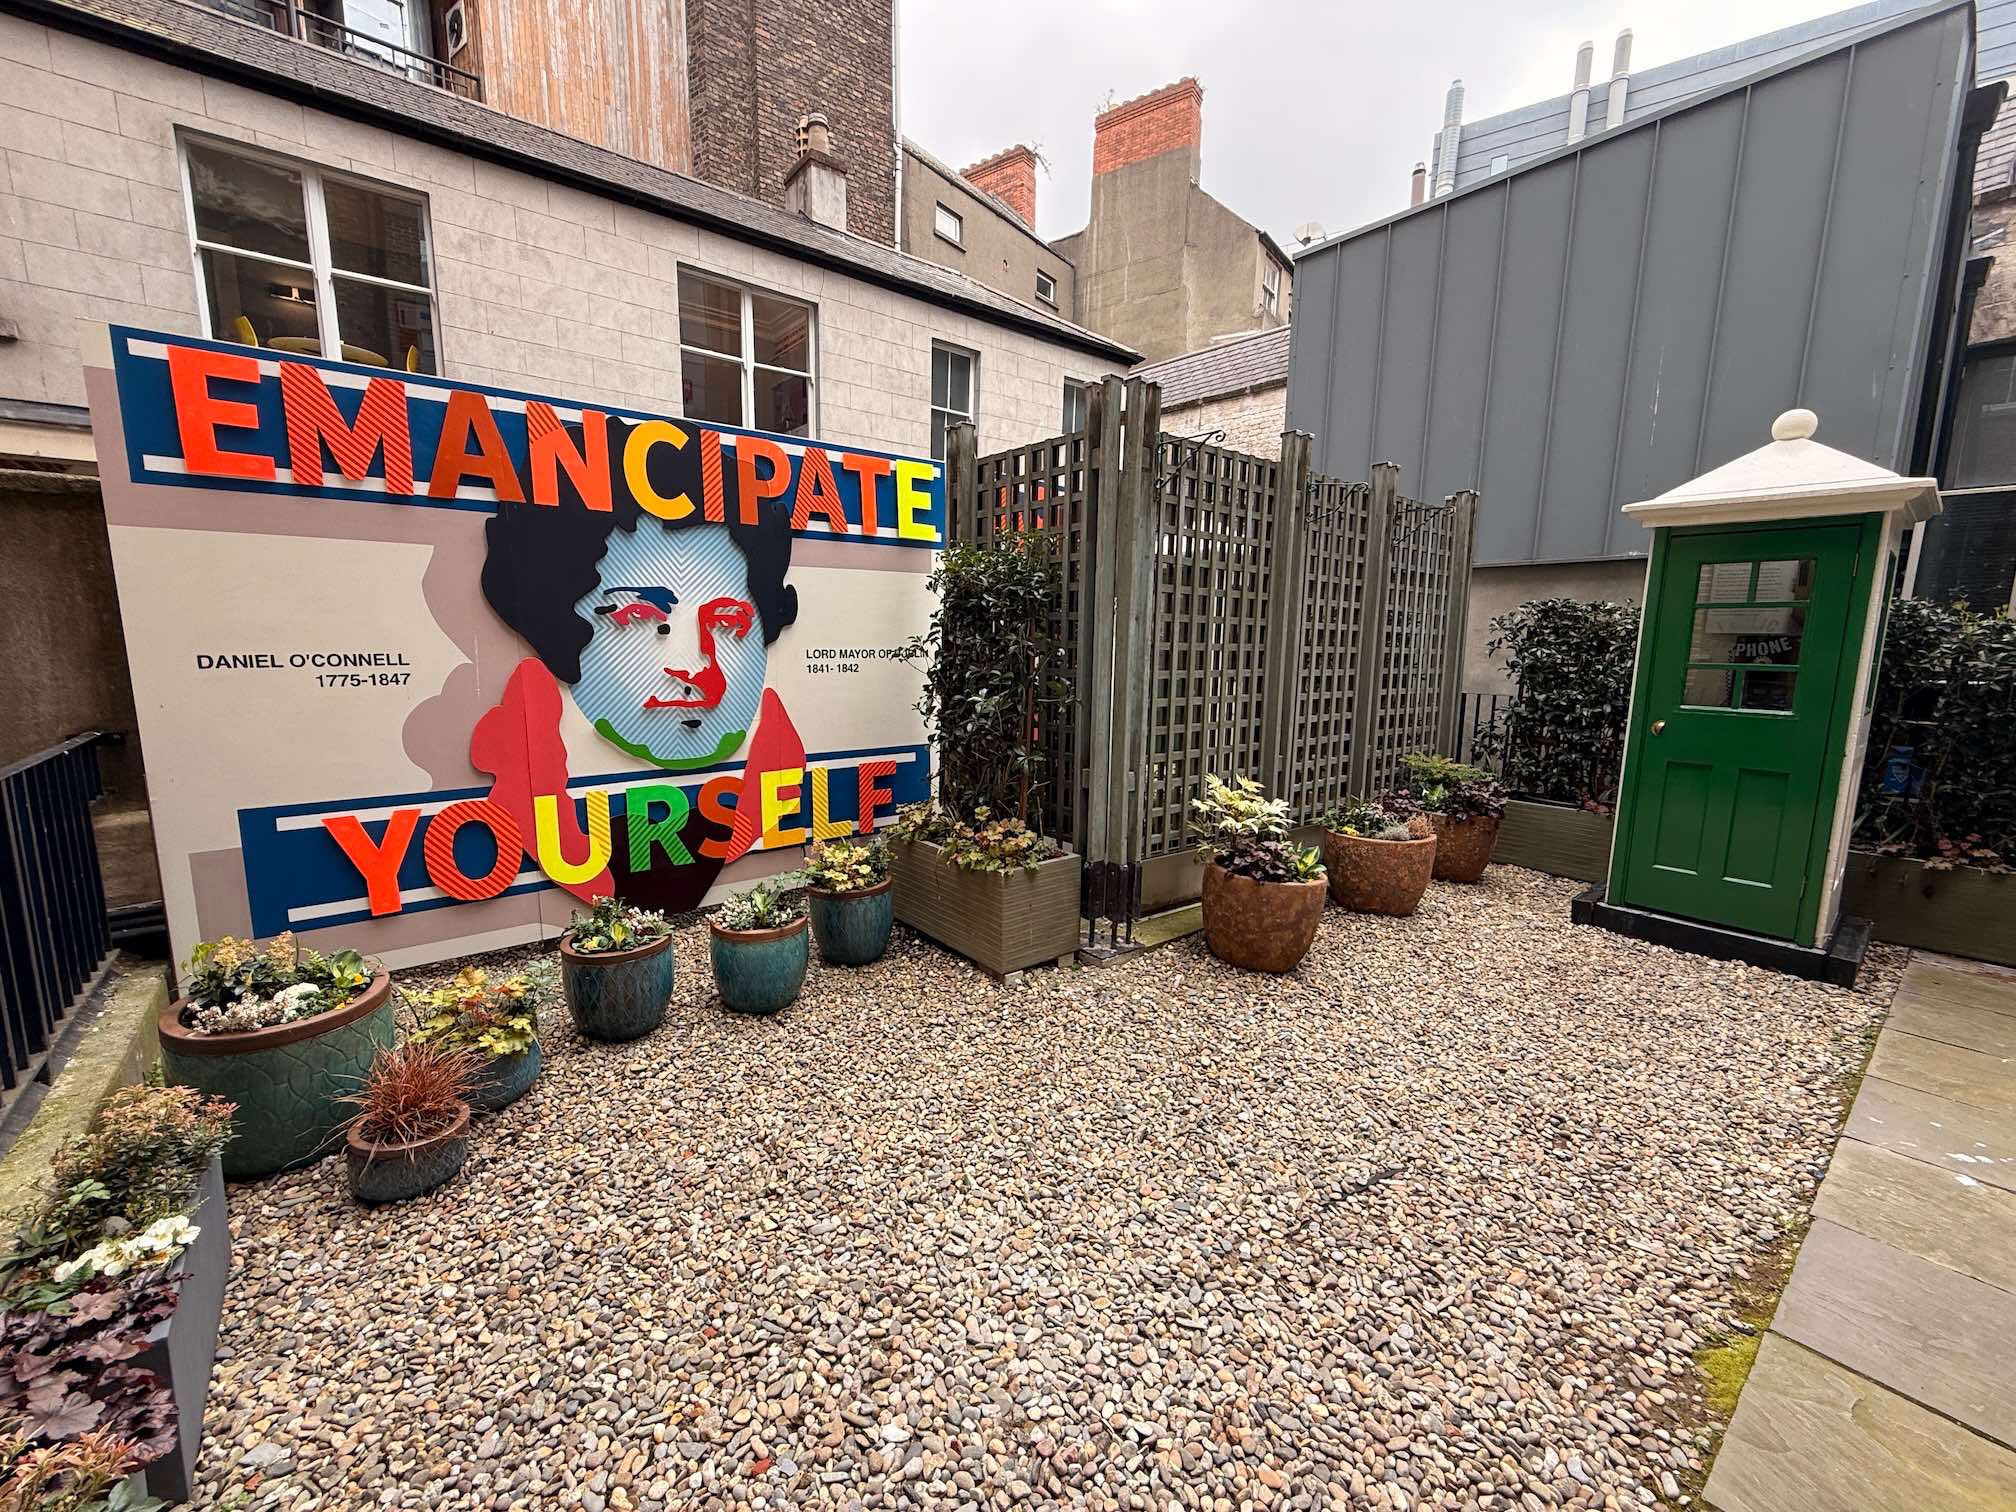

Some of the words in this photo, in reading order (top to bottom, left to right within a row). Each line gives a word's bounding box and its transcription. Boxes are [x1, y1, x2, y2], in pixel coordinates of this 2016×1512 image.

[166, 345, 942, 543] EMANCIPATE
[805, 649, 836, 659] LORD
[839, 649, 876, 659] MAYOR
[1735, 637, 1793, 657] PHONE
[196, 654, 284, 669] DANIEL
[289, 653, 410, 668] O'CONNELL
[836, 664, 860, 673] 1842
[315, 673, 411, 688] 1775-1847
[322, 760, 898, 916] YOURSELF
